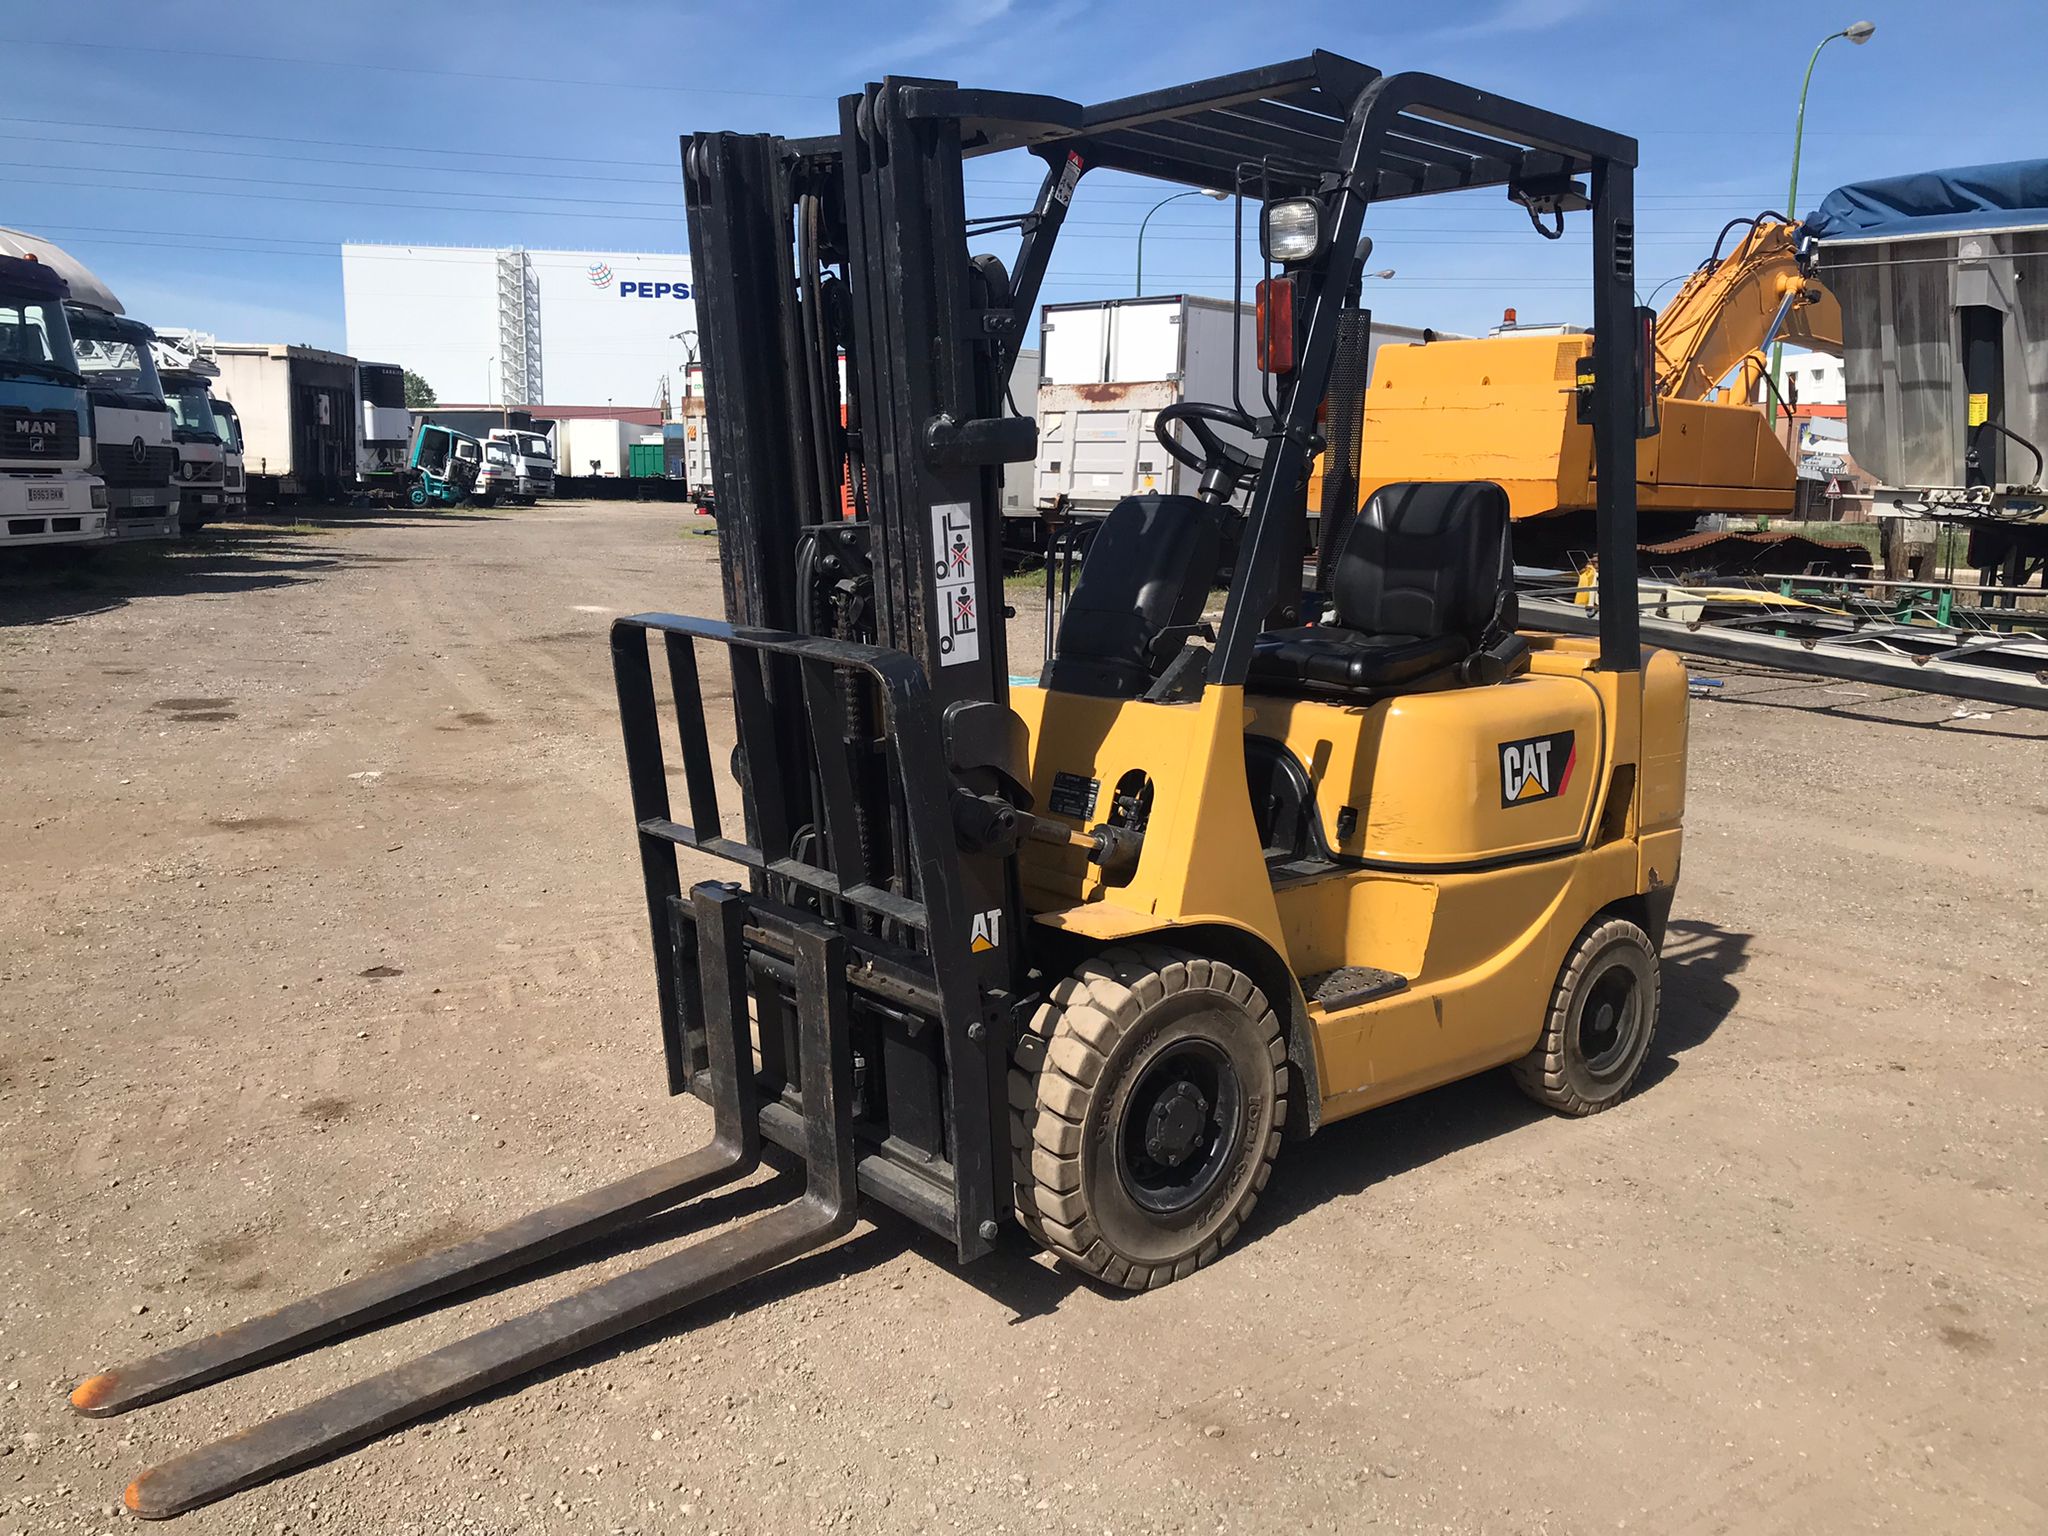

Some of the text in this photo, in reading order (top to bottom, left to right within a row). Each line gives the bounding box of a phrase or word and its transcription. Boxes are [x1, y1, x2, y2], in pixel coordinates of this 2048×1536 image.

[15, 420, 56, 434] MAN
[1503, 740, 1552, 801] CAT
[970, 908, 1002, 948] AT
